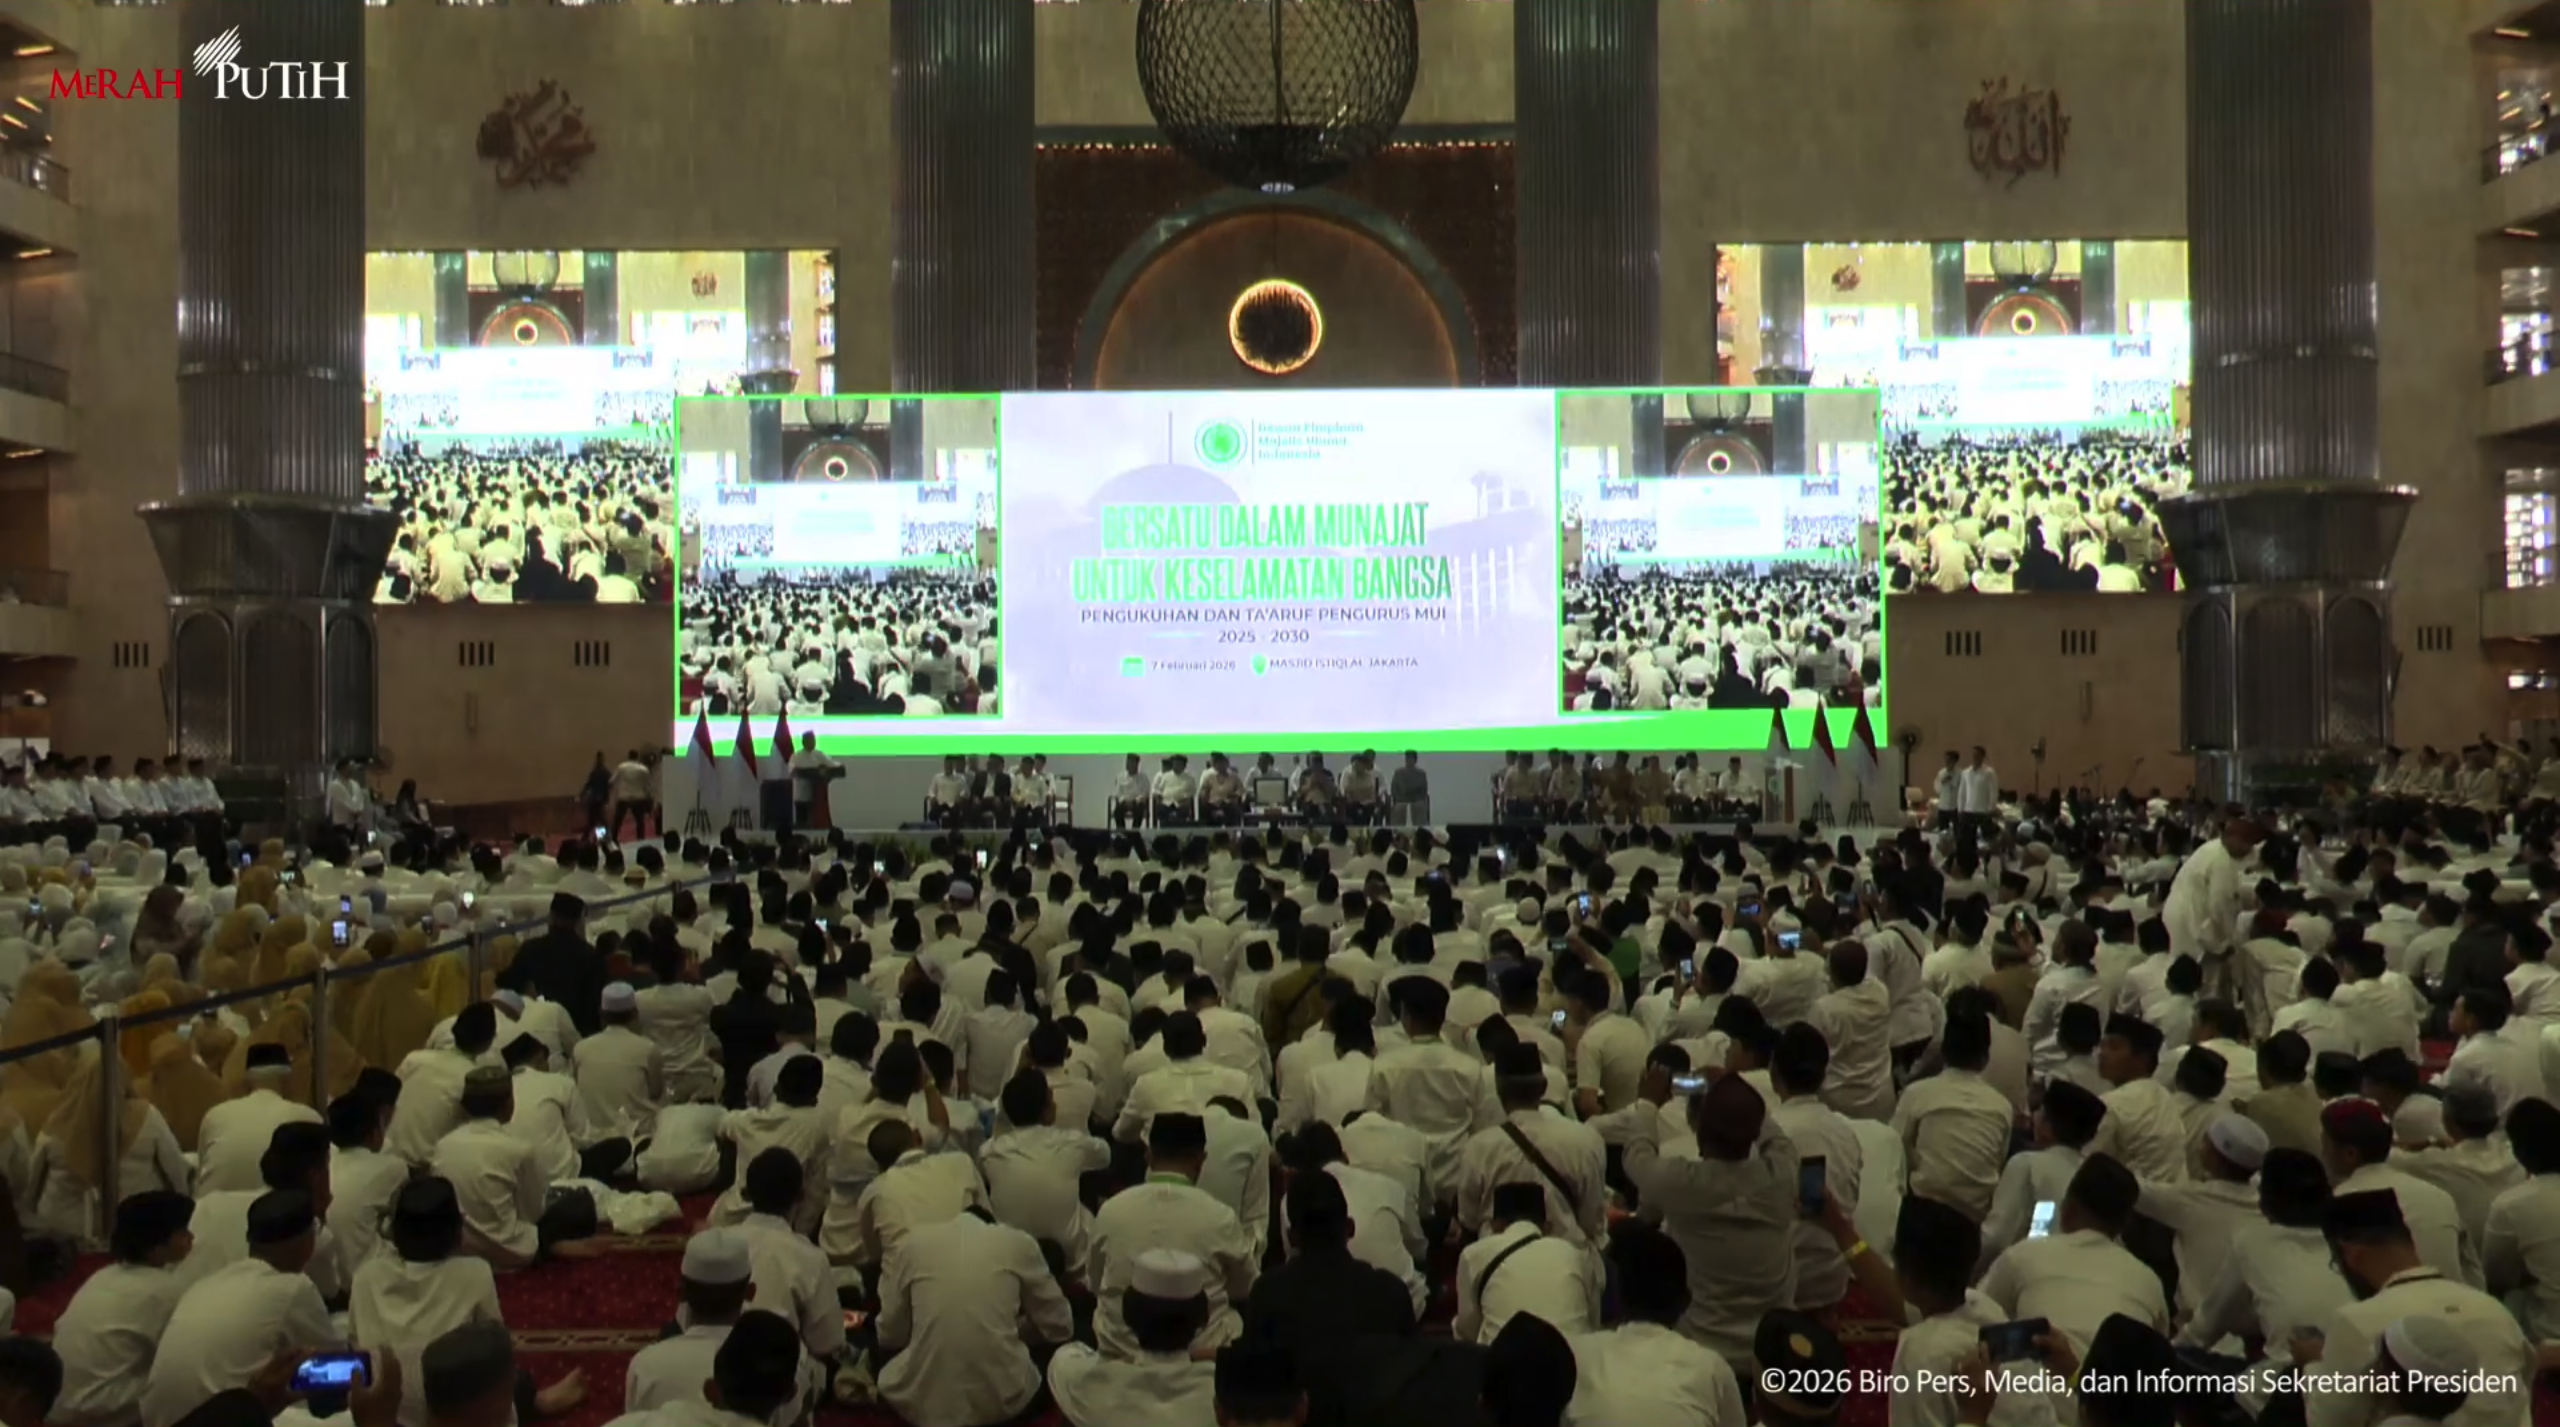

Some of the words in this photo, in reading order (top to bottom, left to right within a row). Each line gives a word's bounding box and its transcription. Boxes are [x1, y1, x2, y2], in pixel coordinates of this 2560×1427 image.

[1102, 504, 1212, 549] BERSATU
[1217, 504, 1305, 548] DALAM
[1314, 502, 1429, 547] MUNAJAT
[1073, 558, 1157, 602] UNTUK
[1163, 557, 1345, 601] KESELAMATAN
[1353, 556, 1452, 600] BANGSA
[1081, 608, 1199, 623] PENGUKUHAN
[1204, 608, 1241, 622] DAN
[1318, 607, 1410, 621] PENGURUS
[1414, 606, 1447, 621] MUI
[1217, 629, 1256, 643] 2025
[1270, 629, 1310, 643] 2030
[1369, 656, 1420, 667] JAKARTA
